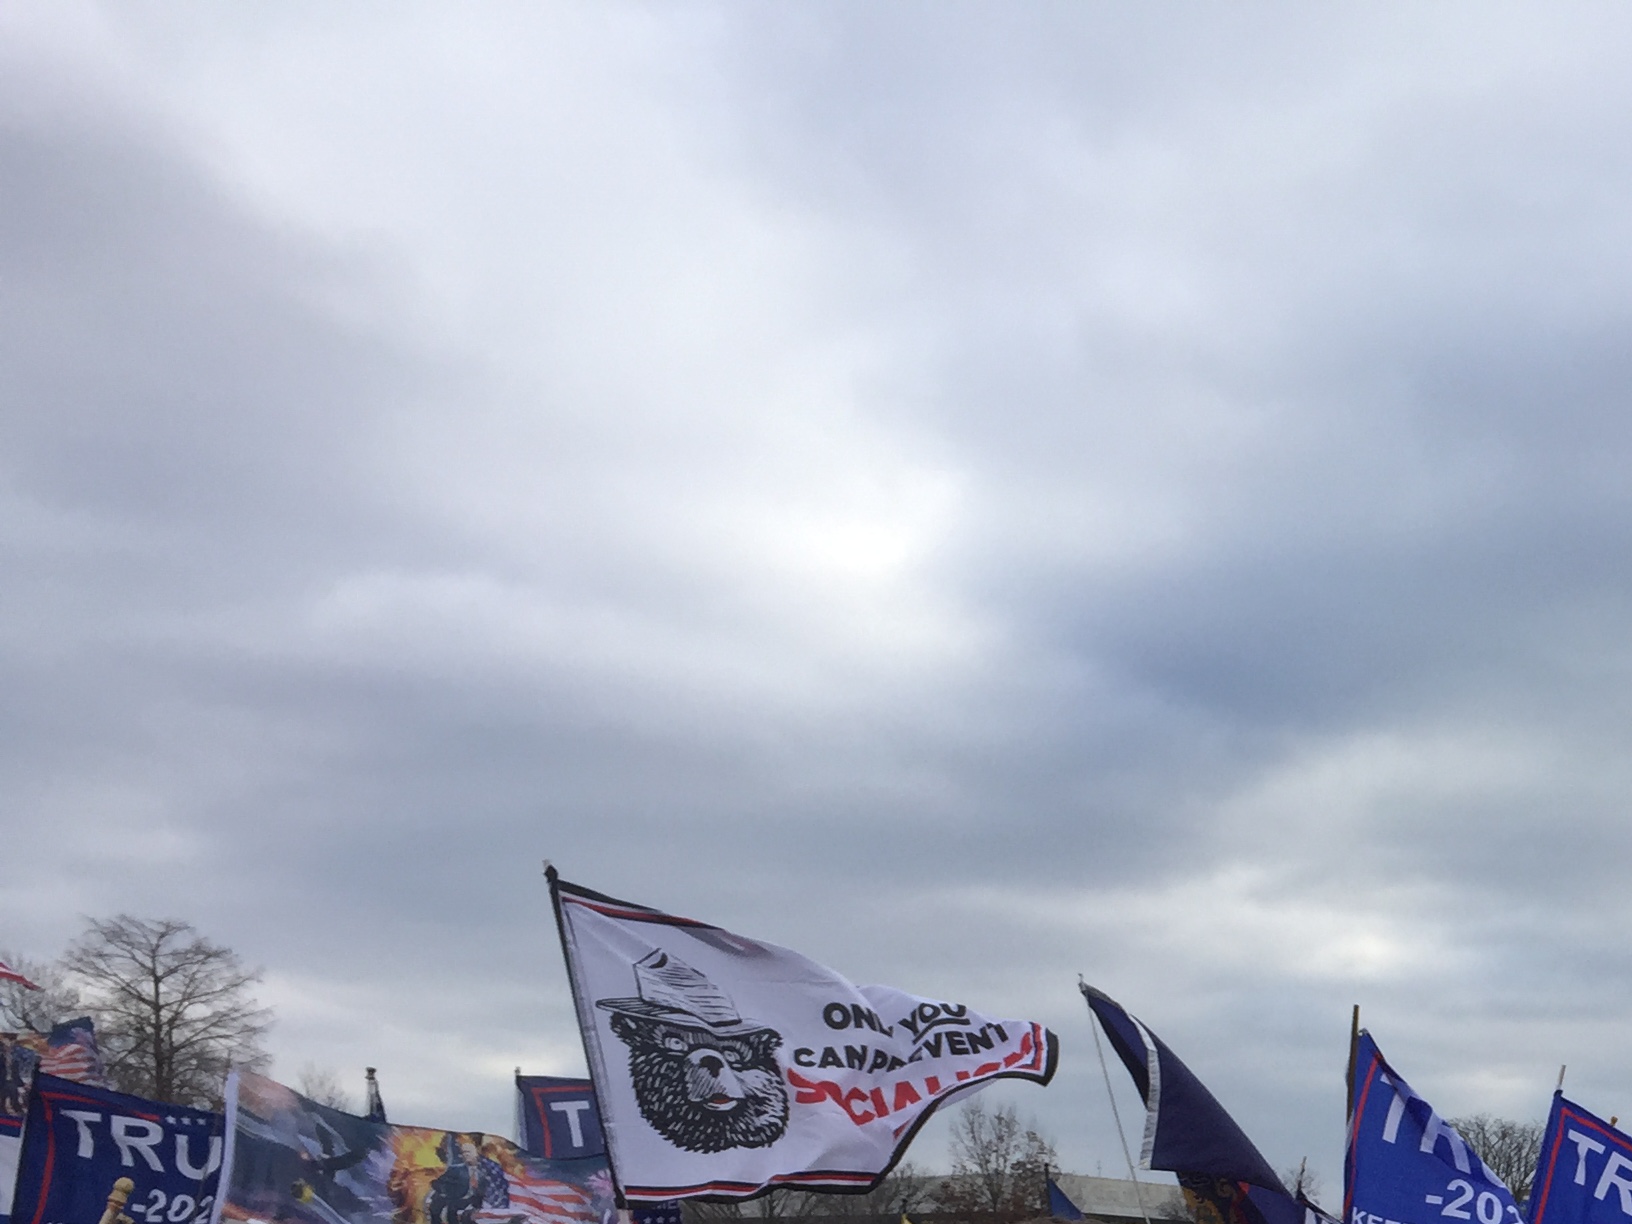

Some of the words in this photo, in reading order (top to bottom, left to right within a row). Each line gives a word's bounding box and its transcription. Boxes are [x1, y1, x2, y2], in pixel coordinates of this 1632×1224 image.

[898, 1002, 968, 1038] YOU
[793, 1044, 868, 1071] CAN
[59, 1108, 223, 1181] TRU
